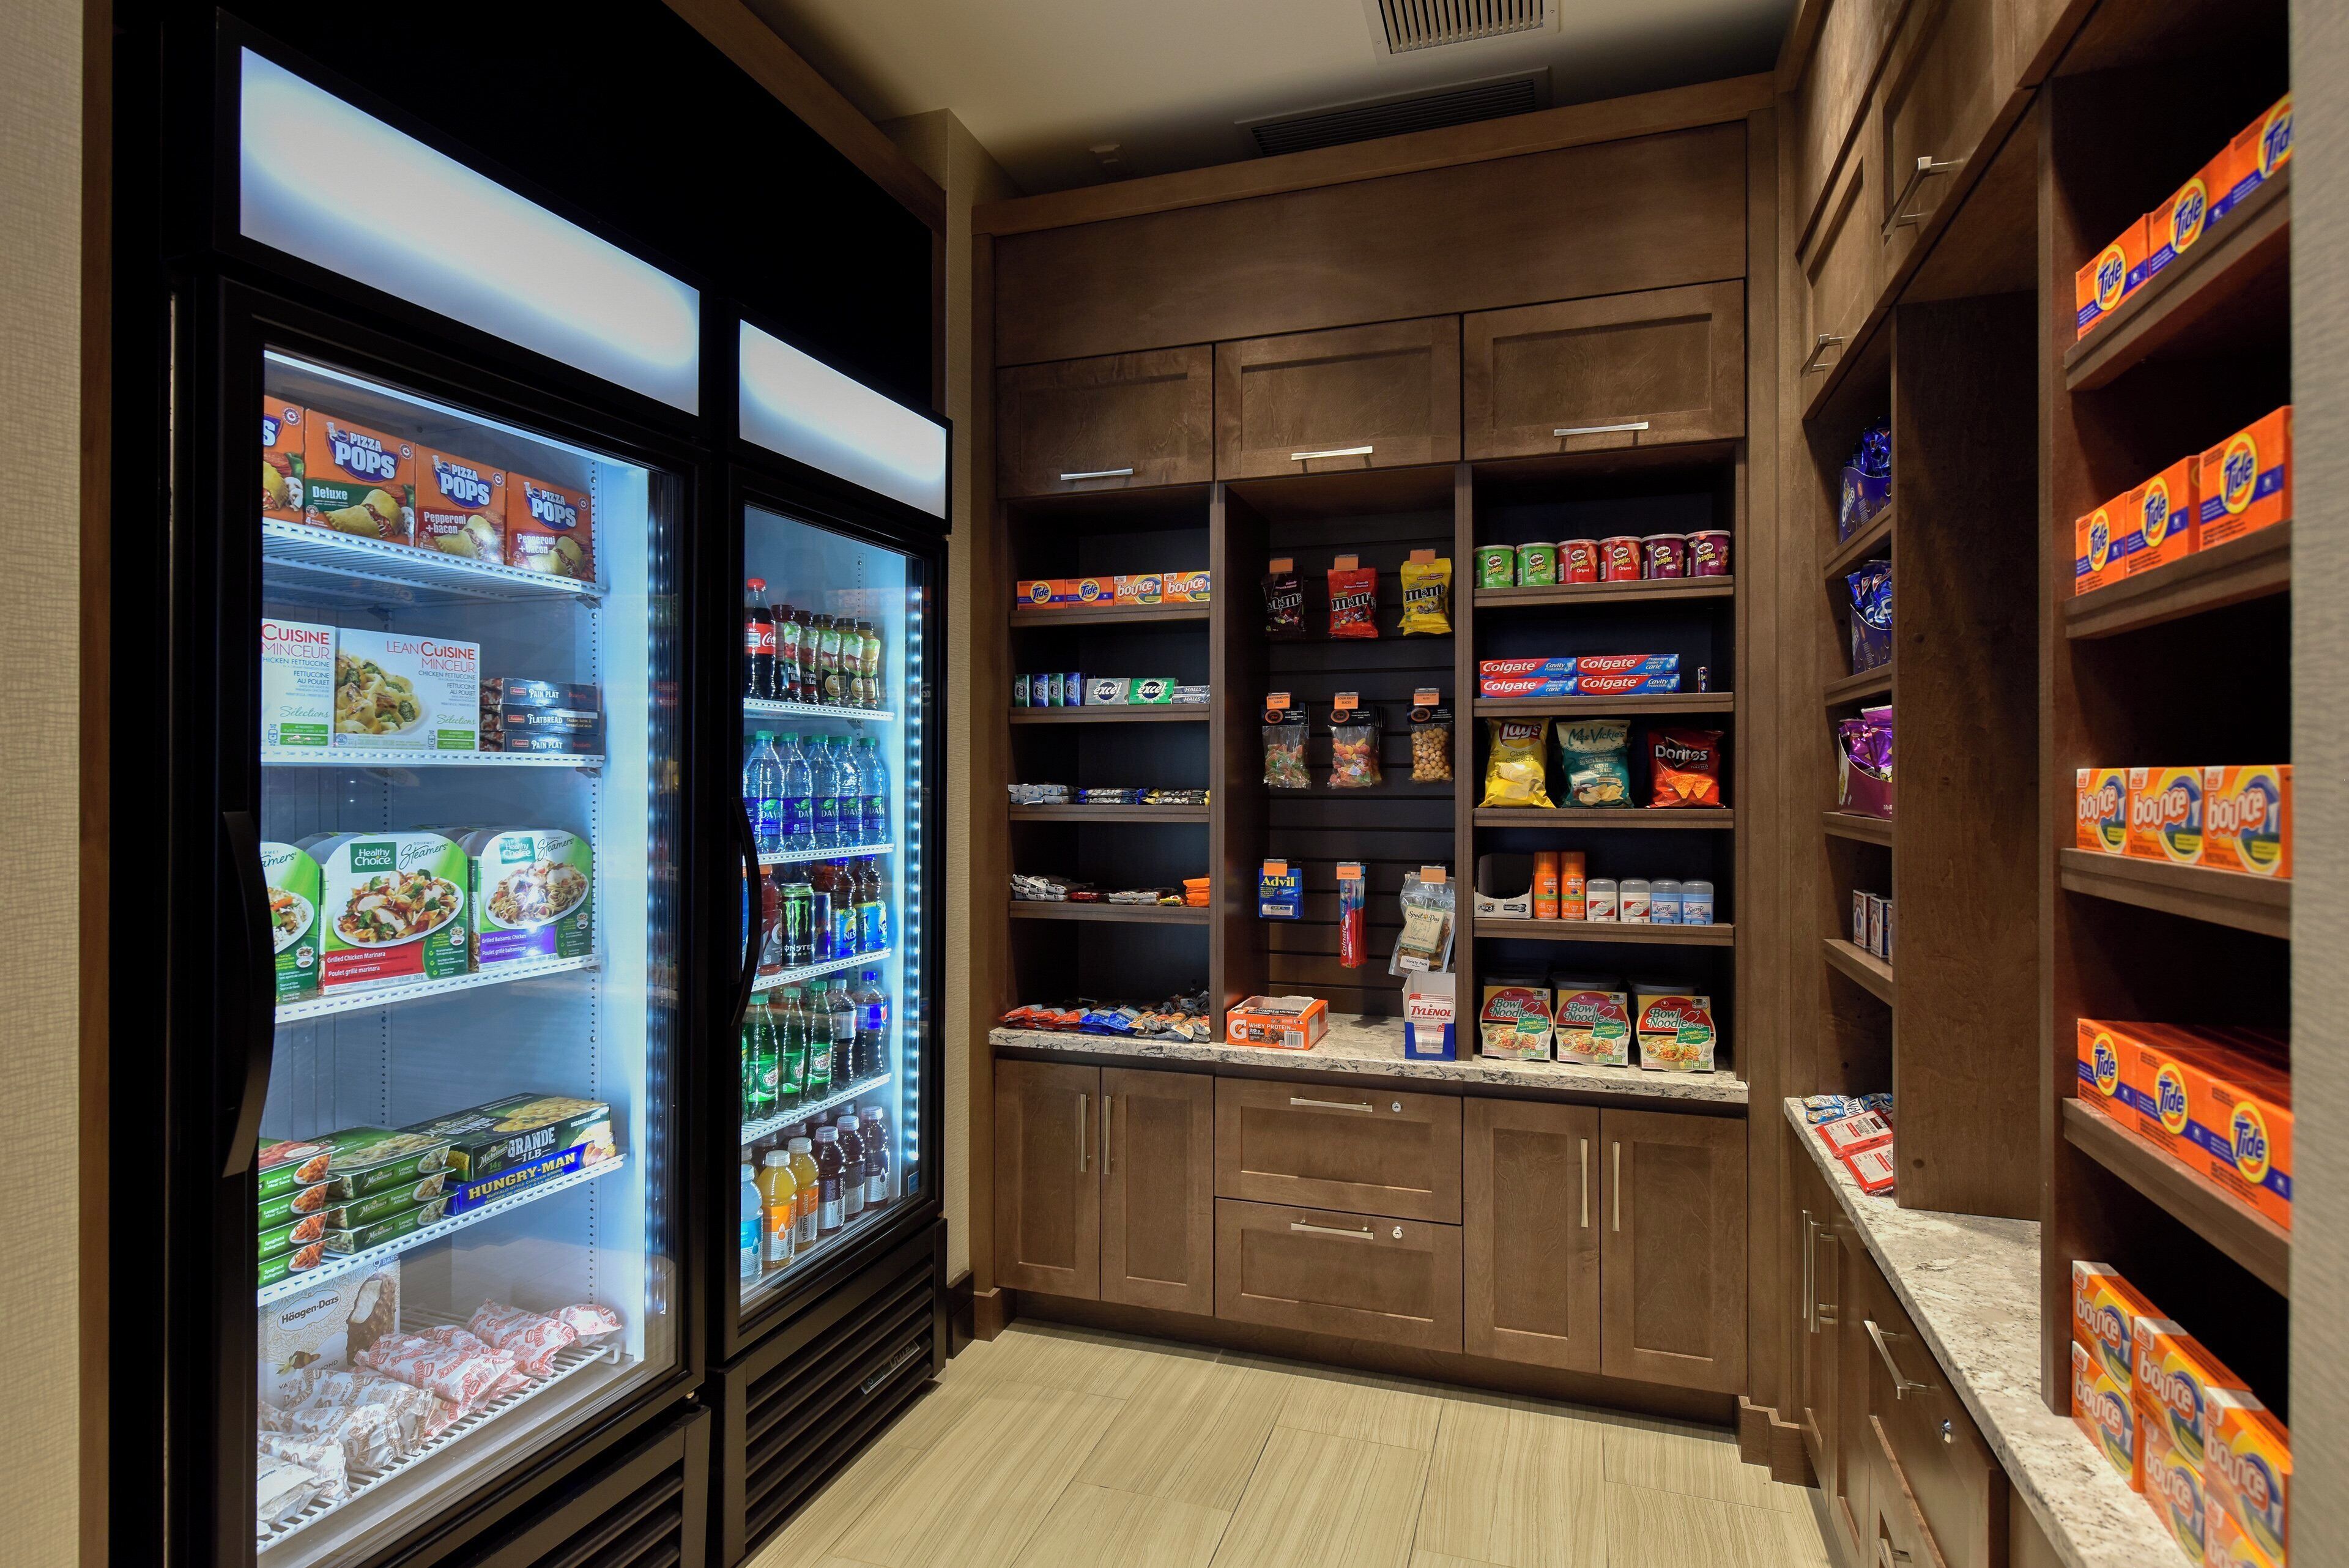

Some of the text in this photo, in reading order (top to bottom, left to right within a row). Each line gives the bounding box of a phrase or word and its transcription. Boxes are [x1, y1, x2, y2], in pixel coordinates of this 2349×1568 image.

[2174, 192, 2204, 248] Tide
[2098, 258, 2123, 305] Tide
[350, 432, 382, 452] PIZZA
[335, 441, 395, 479] POPS
[451, 464, 478, 481] PIZZA
[2223, 450, 2254, 505] Tide
[313, 486, 348, 500] Deluxe
[440, 472, 489, 505] POPS
[542, 490, 565, 505] PIZZA
[1841, 488, 1855, 522] OREO
[424, 511, 466, 524] Pepperoni
[532, 497, 576, 527] POPS
[2145, 491, 2167, 540] Tide
[426, 522, 458, 534] +bacon
[518, 533, 555, 544] Pepperoni
[2090, 521, 2107, 565] Tide
[1570, 560, 1588, 571] Pringles
[1612, 556, 1631, 569] Pringles
[1654, 555, 1673, 568] Pringles
[1696, 551, 1716, 565] Pringles
[1487, 565, 1504, 577] Pringles
[1529, 564, 1546, 575] Pringles
[1032, 586, 1049, 600] Tide
[1081, 584, 1098, 597] Tide
[1117, 581, 1153, 596] bounce
[1167, 578, 1205, 595] bounce
[262, 623, 330, 645] CUISINE
[262, 643, 330, 659] MINCEUR
[387, 641, 475, 660] LEAN CUISINE
[422, 658, 475, 672] MINCEUR
[1483, 661, 1535, 673] Colgate
[1580, 658, 1636, 669] Colgate
[1093, 682, 1123, 695] excel
[1137, 682, 1166, 694] excel
[1483, 680, 1536, 693] Colgate
[1581, 677, 1636, 689] Colgate
[529, 689, 544, 698] PAIN
[527, 714, 562, 724] FLATBREAD
[1590, 727, 1625, 743] Vickie's
[532, 740, 546, 749] PAIN
[1655, 745, 1708, 763] Doritos
[2080, 789, 2115, 819] bounce
[2134, 792, 2187, 825] bounce
[2209, 792, 2264, 831] bounce
[359, 849, 390, 857] Healthy
[399, 843, 447, 869] Steamers
[537, 838, 573, 861] Steamers
[355, 856, 390, 866] Choice
[1261, 877, 1294, 886] Advil
[1408, 910, 1440, 923] Spoil Dog
[328, 954, 343, 963] Grilled
[344, 953, 363, 961] Chicken
[358, 965, 380, 974] marinara
[1411, 1005, 1452, 1016] TYLENOL
[1493, 998, 1523, 1008] Bowl
[1567, 1002, 1598, 1013] Bowl
[1490, 1008, 1528, 1018] Noodle
[1564, 1012, 1605, 1022] Noodle
[1649, 1008, 1681, 1019] Bowl
[1230, 1019, 1247, 1039] G
[1646, 1018, 1688, 1028] Noodle
[2095, 1049, 2115, 1079] Tide
[2158, 1080, 2184, 1115] Tide
[508, 1126, 555, 1157] GRANDE
[2234, 1121, 2265, 1160] Tide
[469, 1153, 575, 1200] HUNGRY-MAN
[487, 1169, 563, 1198] BUFFALO STYLE CHICKEN STRIPS
[544, 1172, 564, 1183] BUFFALO
[373, 1254, 398, 1270] 9 BARS
[281, 1294, 340, 1324] Häagen-Dazs
[2076, 1288, 2120, 1341] bounce
[318, 1360, 338, 1370] MOND
[2140, 1348, 2193, 1414] bounce
[2075, 1365, 2120, 1428] bounce
[2206, 1423, 2265, 1501] bounce
[2145, 1438, 2191, 1509] bounce
